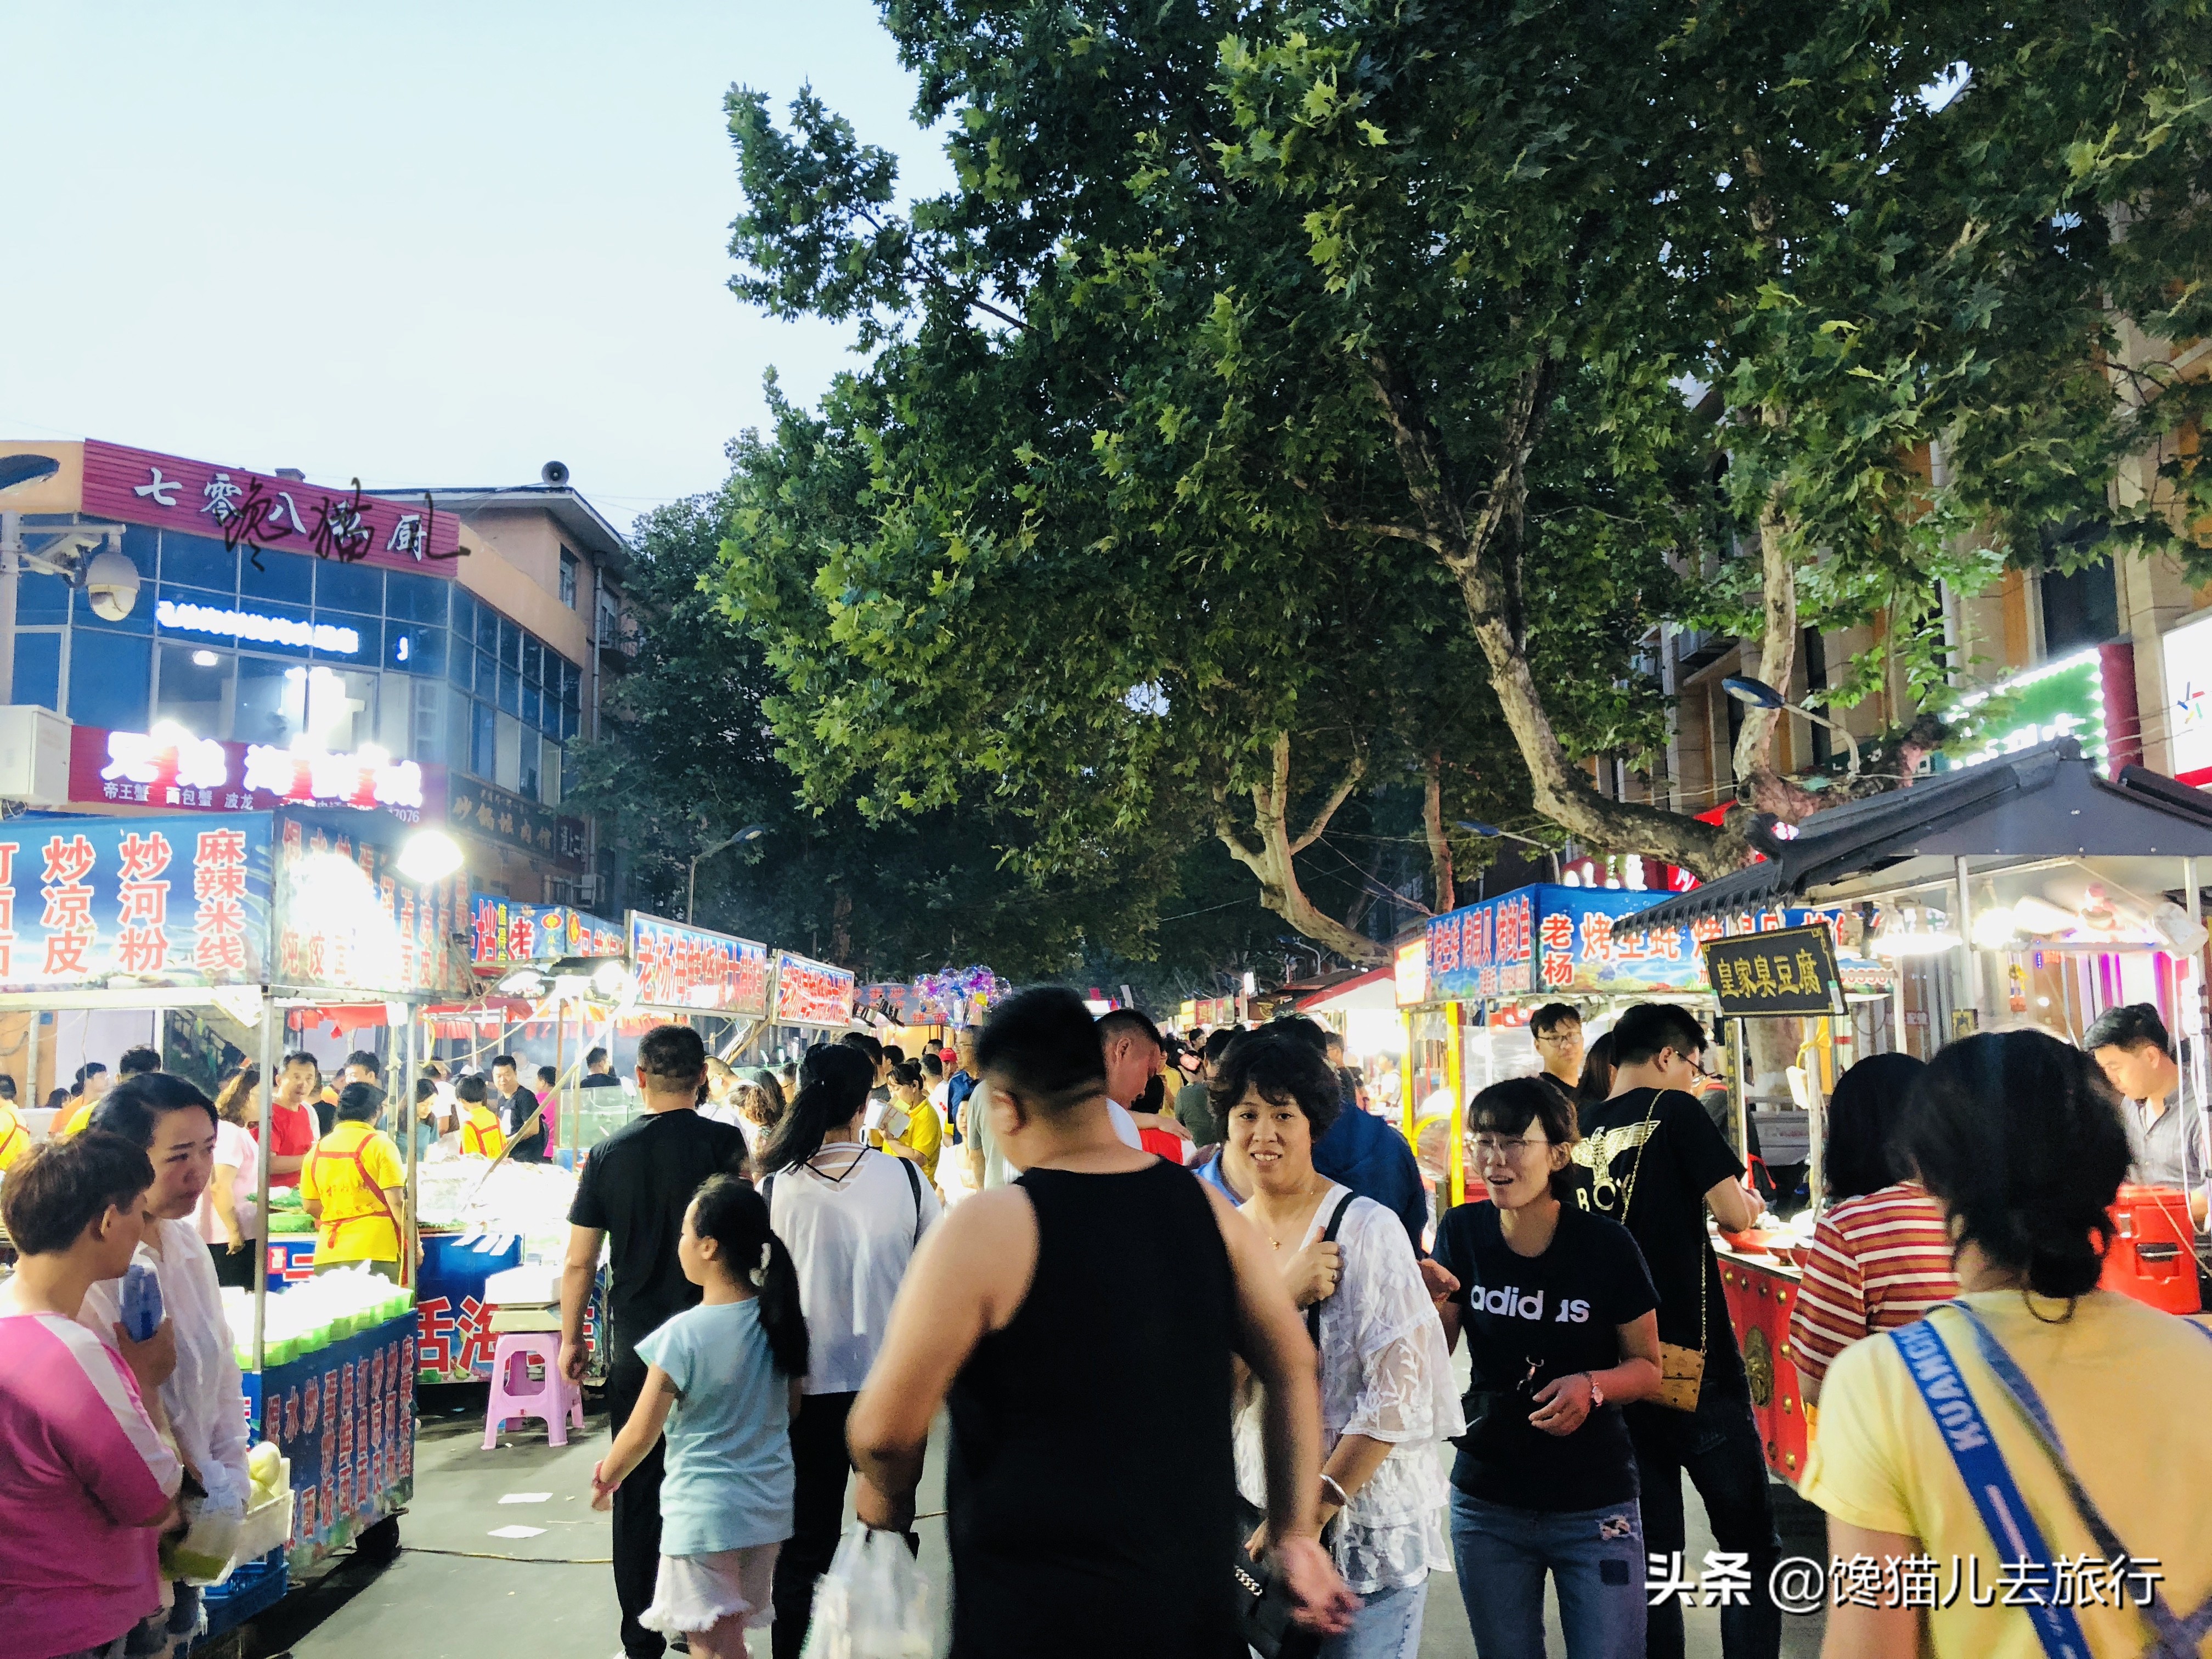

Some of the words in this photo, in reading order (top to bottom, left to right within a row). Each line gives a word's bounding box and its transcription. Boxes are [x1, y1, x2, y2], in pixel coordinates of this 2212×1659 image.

[134, 468, 427, 561] 七零八私厨
[104, 782, 149, 802] 帝王蟹
[166, 786, 212, 807] 面包蟹
[225, 793, 253, 810] 波龙
[41, 835, 96, 975] 炒凉皮
[117, 831, 173, 973] 炒河粉
[193, 828, 248, 970] 麻辣米线
[1541, 913, 1574, 987] 老杨
[1717, 948, 1821, 998] 皇家臭豆腐
